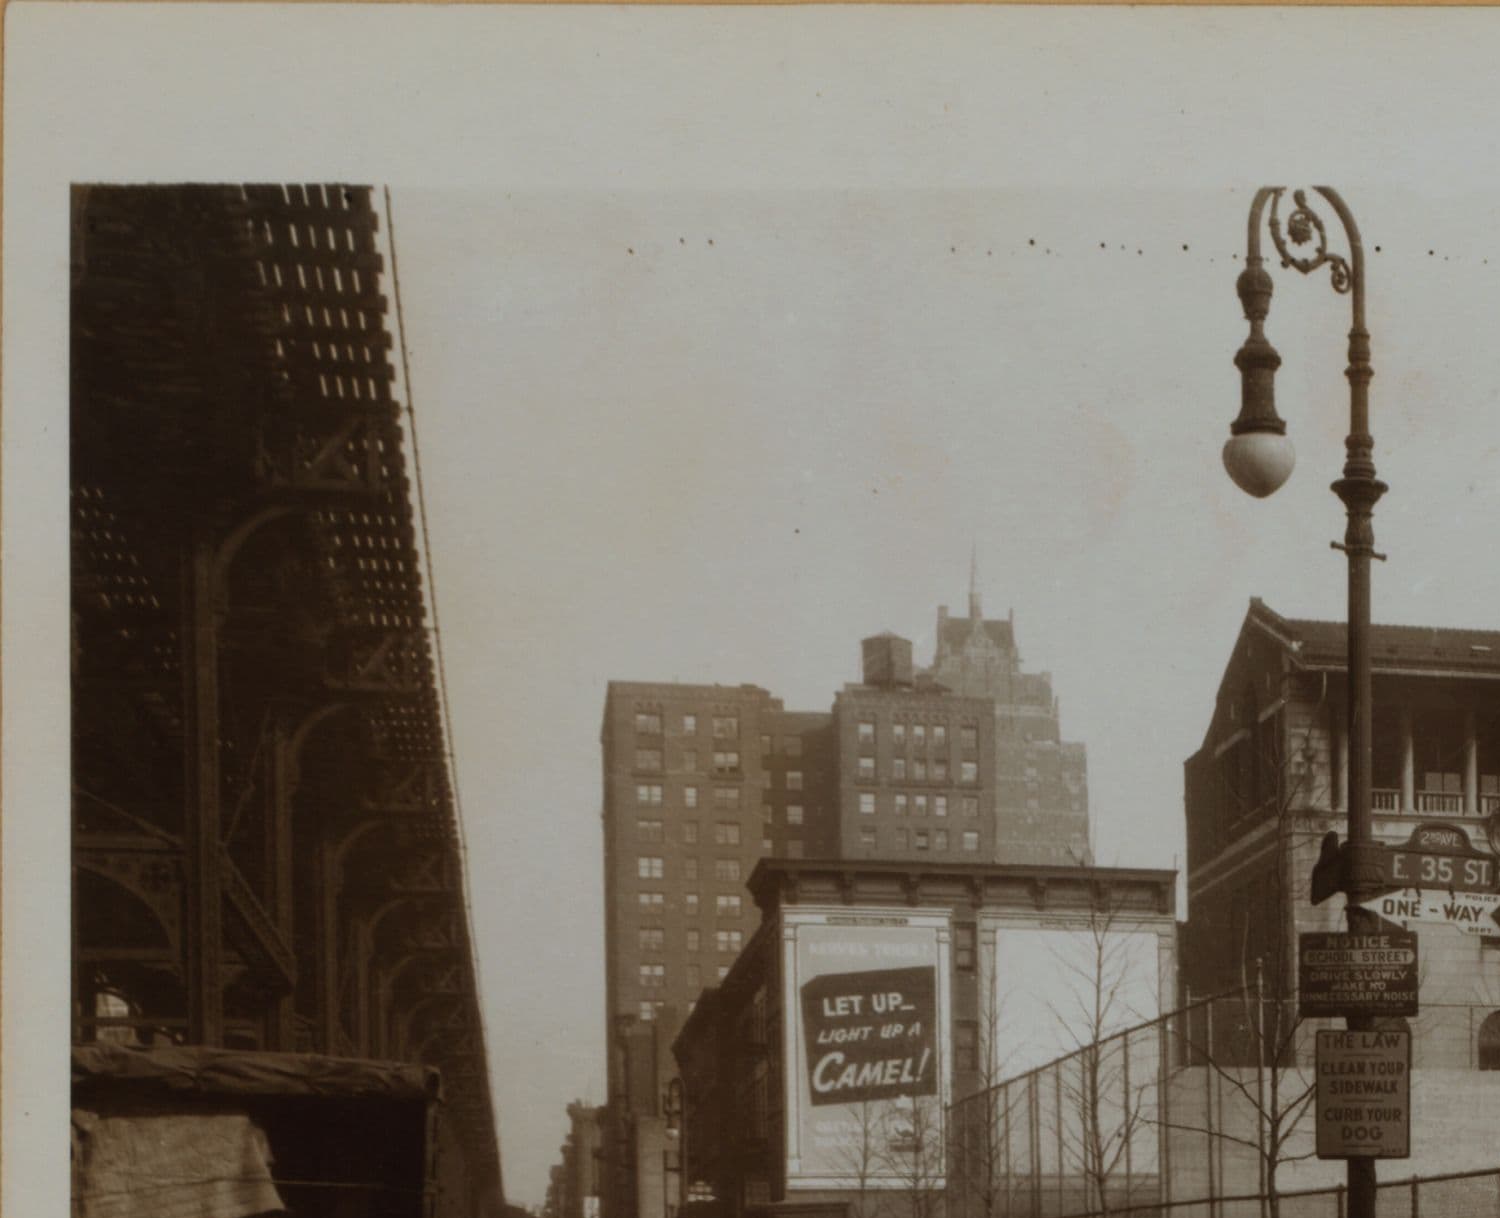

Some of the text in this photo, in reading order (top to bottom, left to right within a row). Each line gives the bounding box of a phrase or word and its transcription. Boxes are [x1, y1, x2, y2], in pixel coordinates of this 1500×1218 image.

[1393, 854, 1409, 879] E.
[1420, 855, 1453, 882] 35
[1464, 894, 1499, 903] POLICE
[1382, 898, 1421, 918] ONE
[1442, 903, 1485, 923] WAY
[1326, 935, 1391, 948] NOTICE
[1308, 950, 1409, 963] SCHOOL STREET
[1310, 970, 1408, 981] DRIVE SLOWLY
[1369, 982, 1387, 991] NO
[1383, 991, 1416, 1002] NOISE
[823, 995, 863, 1018] LET
[817, 1021, 921, 1044] LIGHT UP A
[1322, 1034, 1401, 1049] THE LAW
[1320, 1062, 1404, 1075] CLEAN YOUR
[1328, 1080, 1399, 1094] SIDEWALK
[1324, 1108, 1402, 1122] CURB YOUR
[1341, 1126, 1384, 1141] DOG
